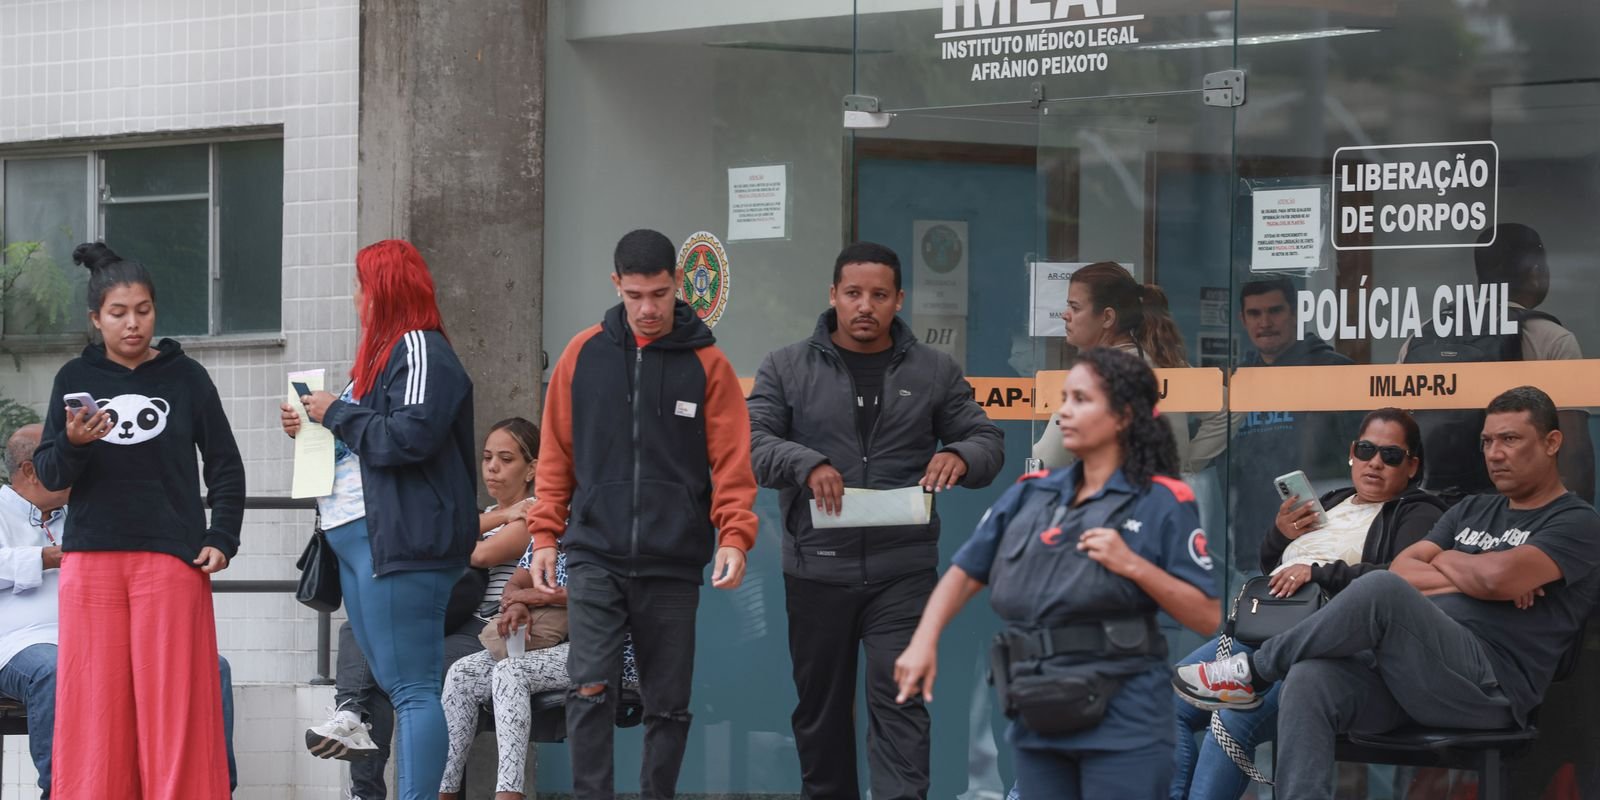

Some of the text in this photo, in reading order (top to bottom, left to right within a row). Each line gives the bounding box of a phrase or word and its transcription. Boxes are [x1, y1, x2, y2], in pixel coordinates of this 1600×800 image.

[942, 26, 1139, 59] INSTITUTO MÉDICO LEGAL
[971, 52, 1108, 81] AFRÂNIO PEIXOTO
[1341, 153, 1489, 196] LIBERAÇÃO
[1341, 205, 1374, 234] DE
[1380, 201, 1487, 233] CORPOS
[1296, 275, 1519, 341] POLÍCIA CIVIL
[925, 328, 953, 345] DH
[1369, 373, 1457, 397] IMLAP-RJ
